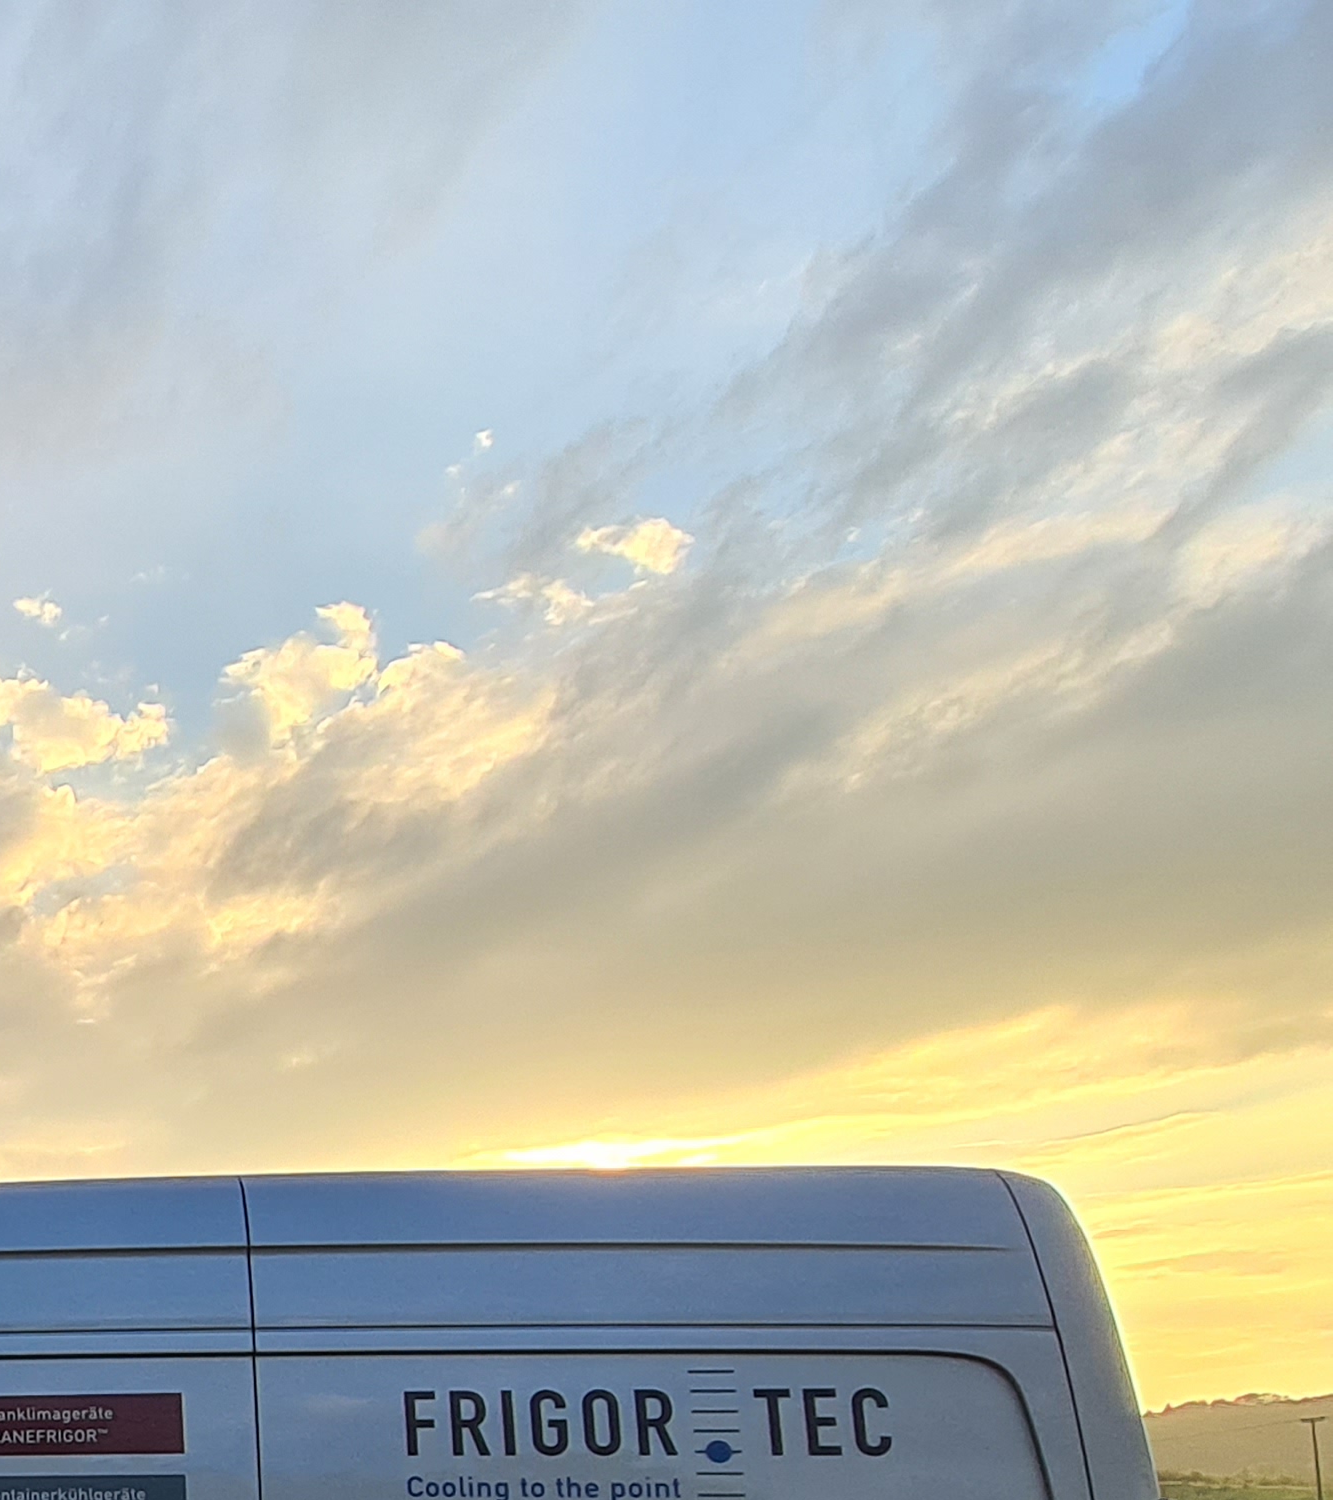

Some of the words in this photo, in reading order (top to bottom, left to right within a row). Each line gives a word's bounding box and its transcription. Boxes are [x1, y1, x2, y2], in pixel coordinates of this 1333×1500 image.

[403, 1388, 679, 1457] FRIGOR
[752, 1387, 893, 1457] TEC
[520, 1477, 545, 1499] to
[555, 1476, 600, 1499] the
